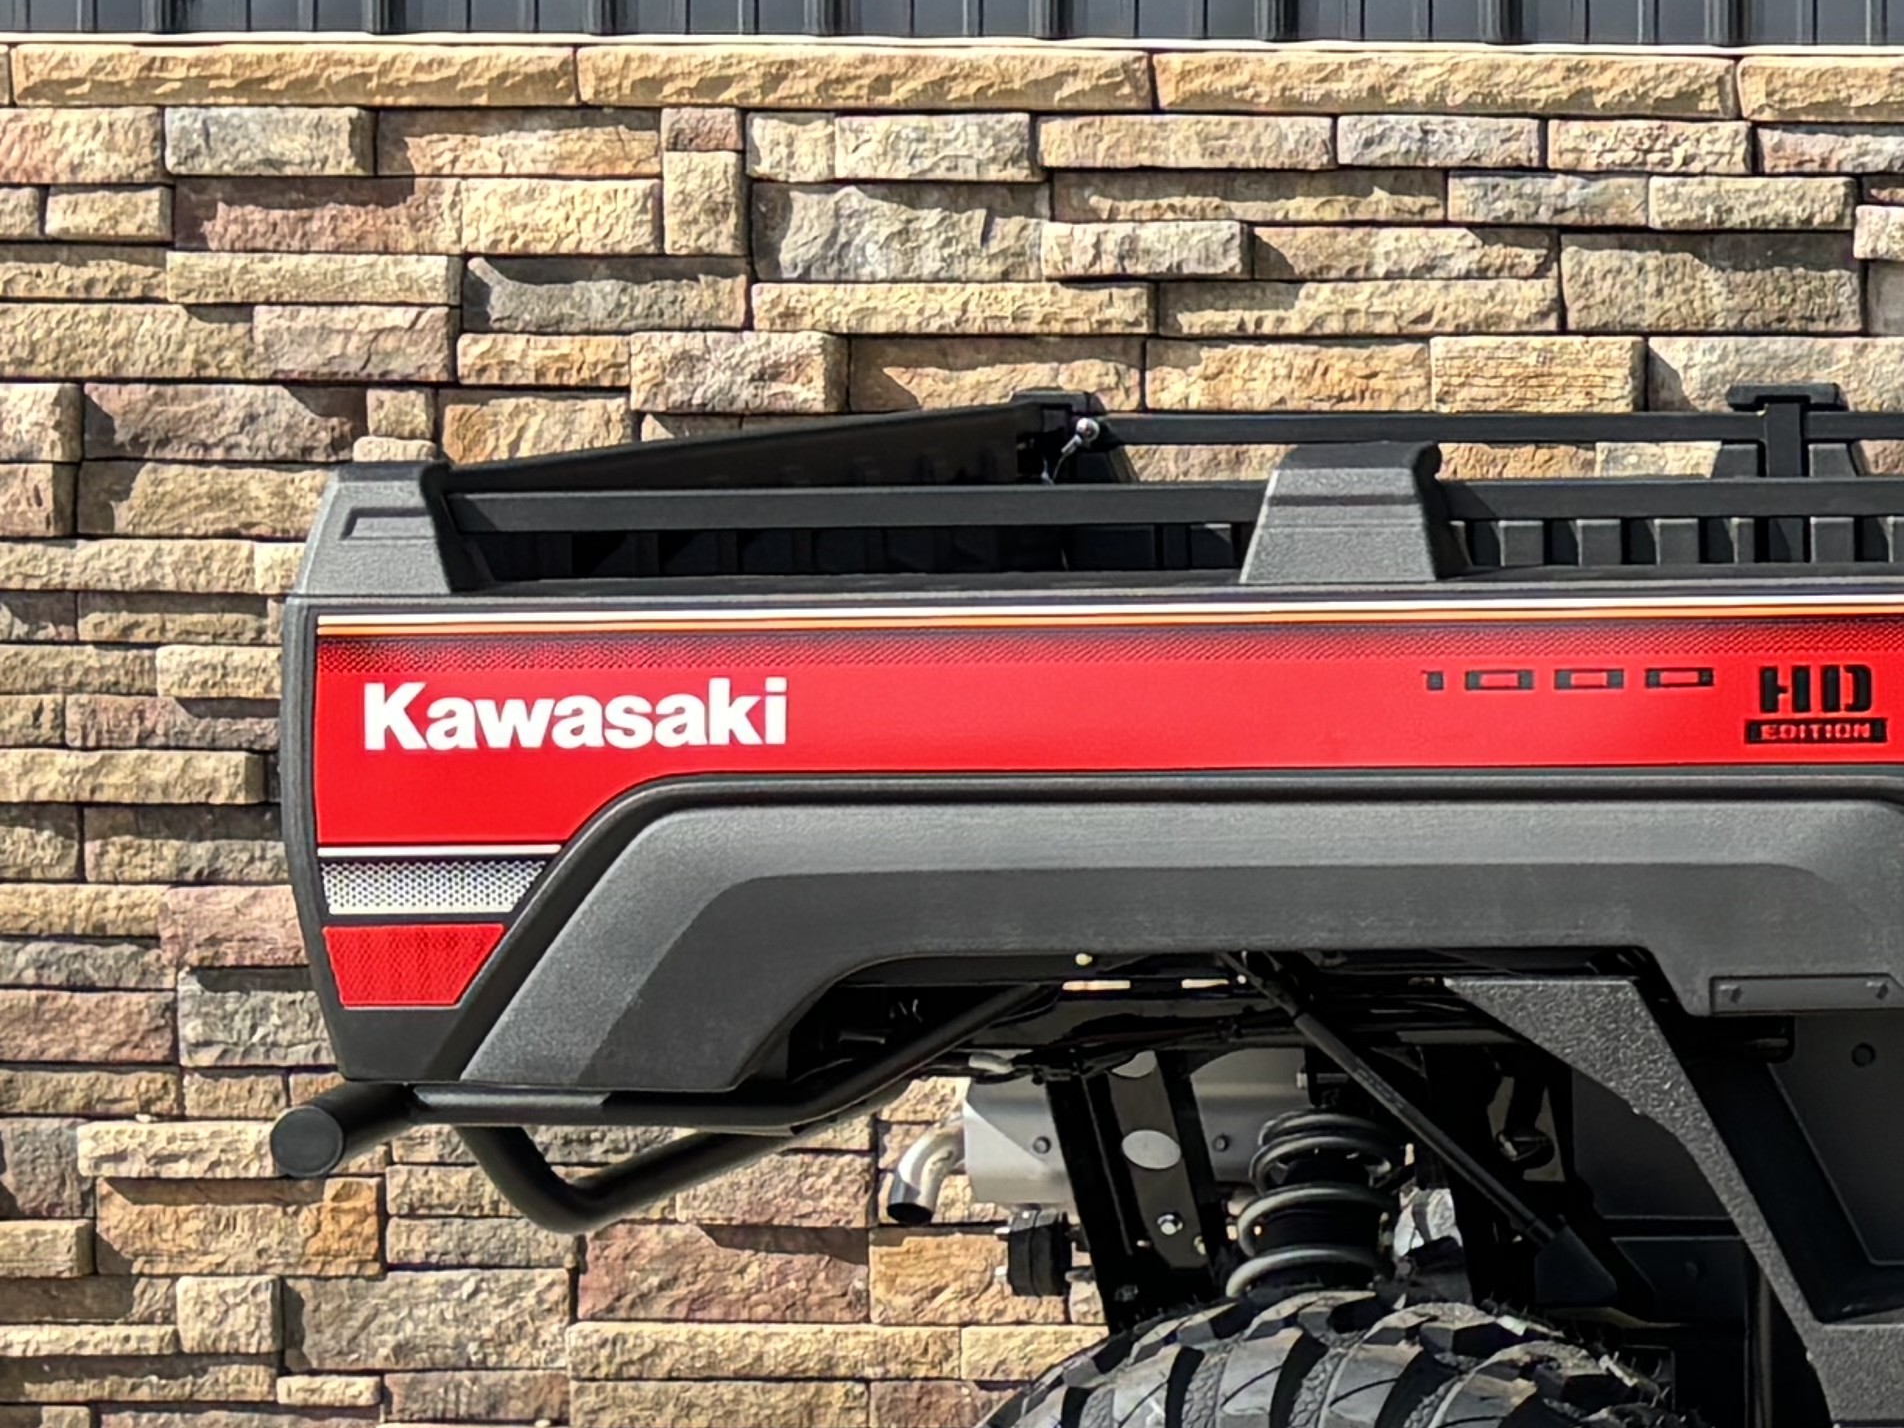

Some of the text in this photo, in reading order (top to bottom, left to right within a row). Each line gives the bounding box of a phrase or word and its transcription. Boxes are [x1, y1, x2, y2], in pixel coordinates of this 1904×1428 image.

[1421, 667, 1714, 691] 1000
[1758, 664, 1873, 714] HD
[364, 677, 787, 751] Kawasaki
[1758, 722, 1872, 741] EDITION
